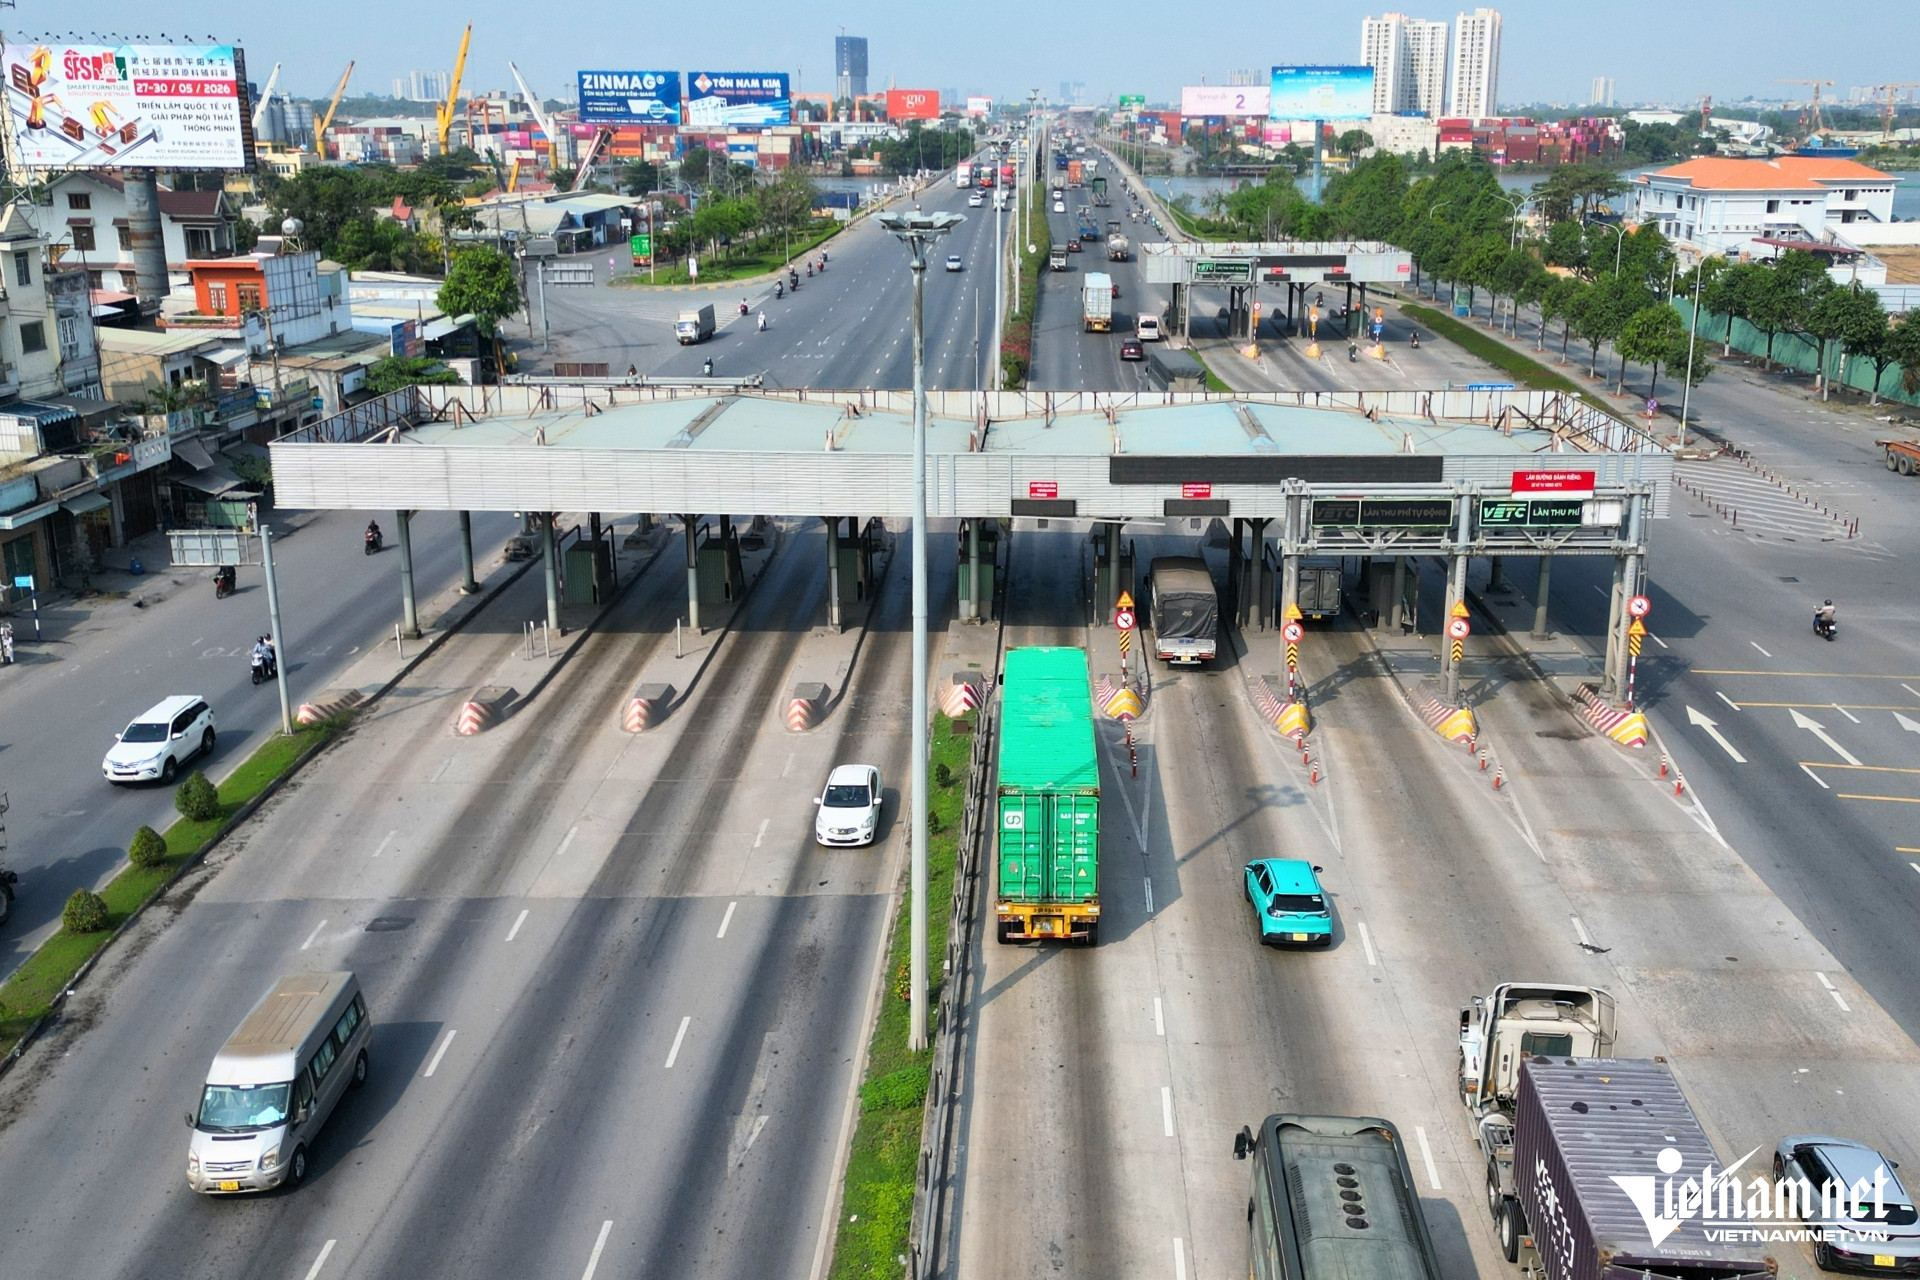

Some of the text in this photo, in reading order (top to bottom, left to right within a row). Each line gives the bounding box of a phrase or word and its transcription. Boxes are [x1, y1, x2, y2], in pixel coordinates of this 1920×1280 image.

[64, 56, 92, 81] SFS
[136, 83, 168, 94] 27-30
[179, 83, 193, 94] 05
[204, 83, 231, 94] 2026
[713, 77, 781, 88] TÔN NAM KIM
[1236, 94, 1245, 109] 2
[183, 124, 235, 132] THÔNG MINH
[1314, 506, 1447, 519] VETC LÀN THU PHÍ TỰ ĐỘNG
[1483, 506, 1580, 519] VETC LÀN THU PHÍ
